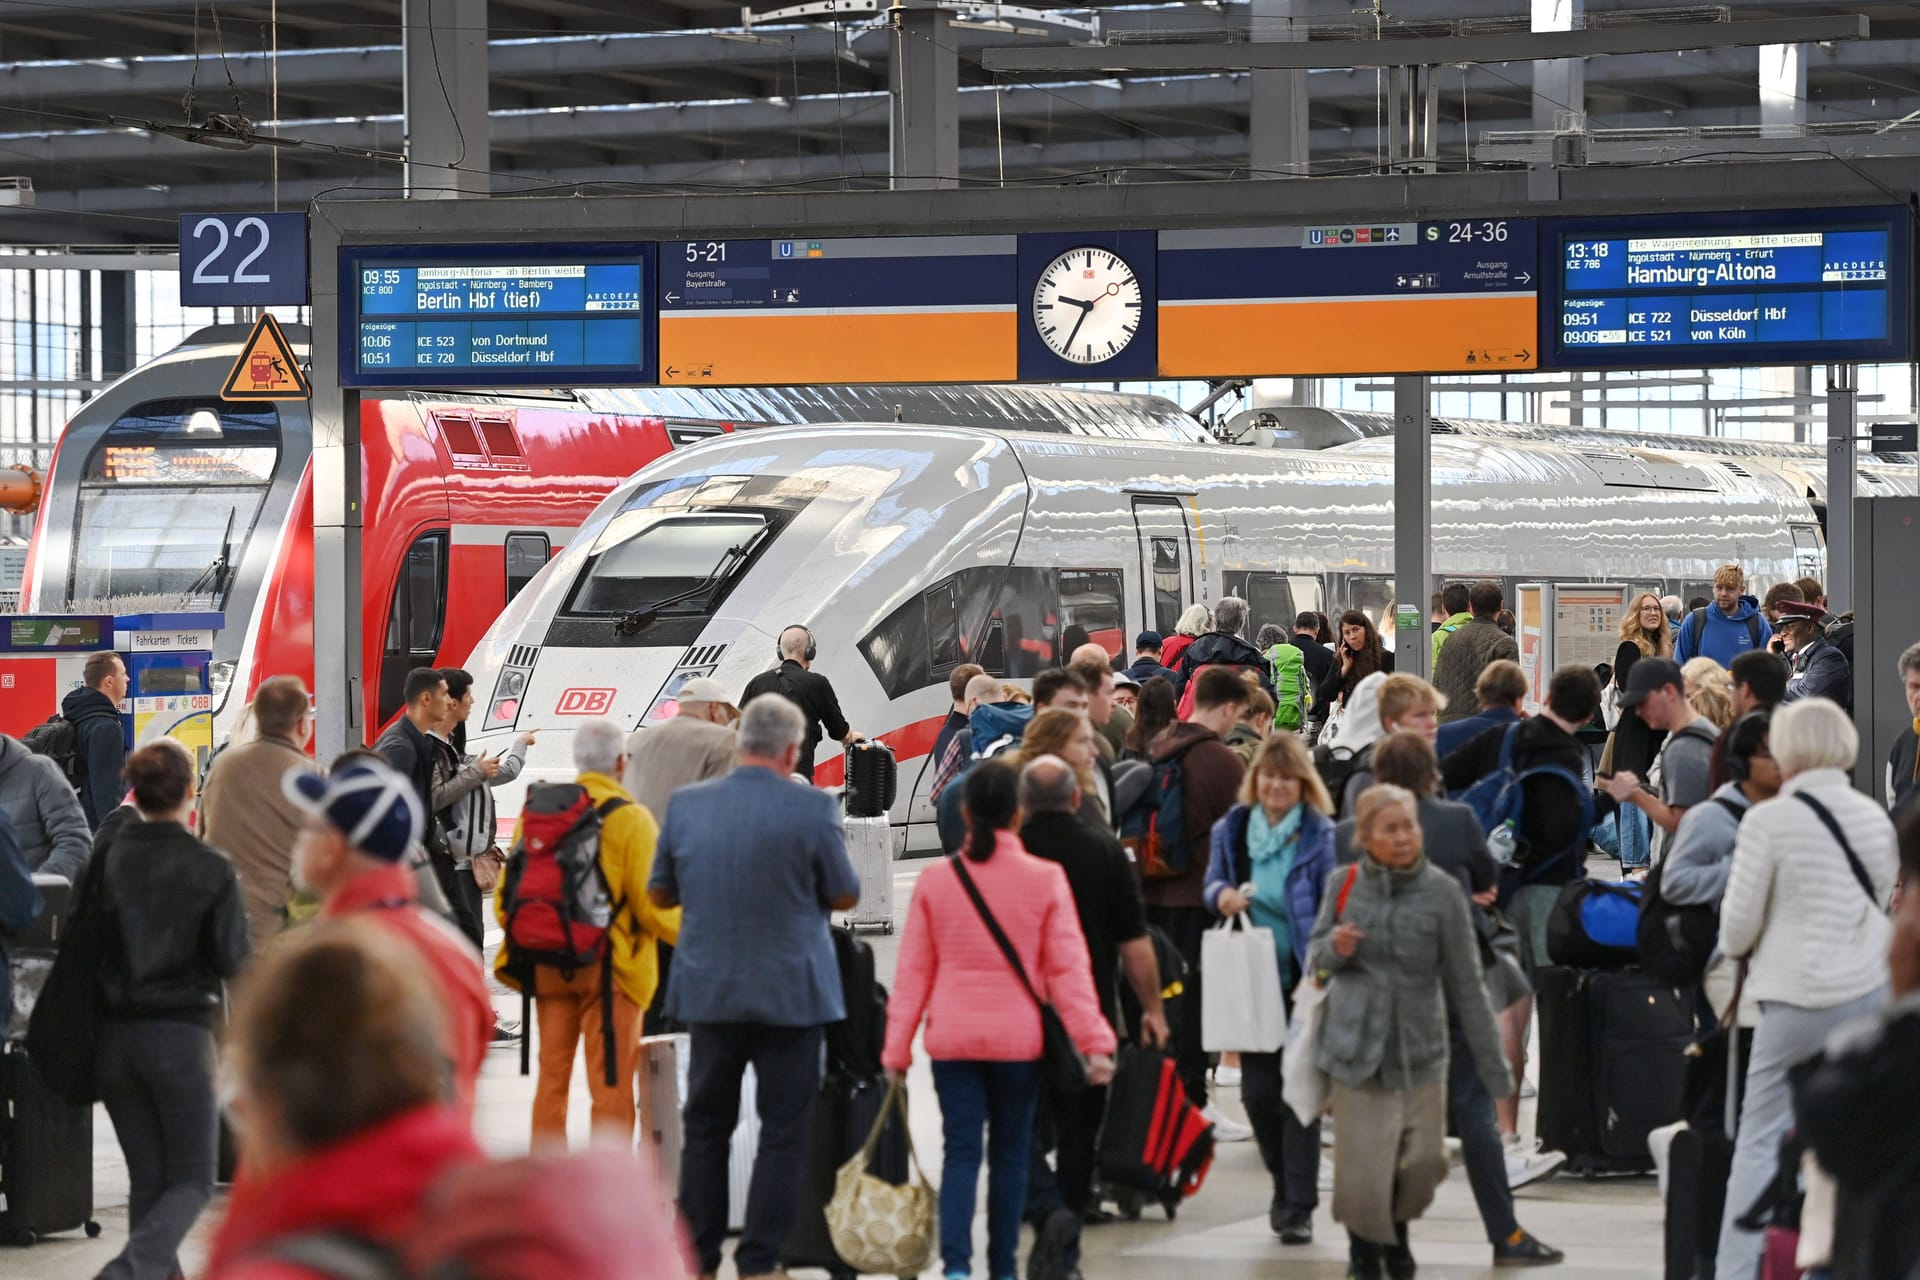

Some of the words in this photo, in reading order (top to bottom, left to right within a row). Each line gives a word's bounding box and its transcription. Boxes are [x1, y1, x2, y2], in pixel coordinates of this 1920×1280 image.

[1312, 231, 1321, 244] U
[1426, 227, 1438, 240] S
[1448, 221, 1508, 243] 24-36
[192, 217, 270, 283] 22
[686, 242, 726, 262] 5-21
[782, 243, 791, 257] U
[1567, 242, 1609, 258] 13:18
[1628, 252, 1675, 264] Ingolstadt
[1689, 251, 1731, 262] Nürnberg
[1745, 250, 1774, 259] Erfurt
[1476, 260, 1508, 270] Ausgang
[1566, 260, 1581, 270] ICE
[1584, 260, 1600, 269] 786
[363, 270, 400, 284] 09:55
[686, 270, 715, 279] Ausgang
[1464, 270, 1508, 279] Arnulfstraße
[1628, 263, 1776, 286] Hamburg-Altona
[363, 286, 376, 294] ICE
[378, 286, 393, 294] 800
[418, 281, 458, 291] Ingolstadt
[470, 280, 507, 291] Nürnberg
[518, 280, 553, 290] Bamberg
[686, 280, 726, 288] Bayerstraße
[418, 293, 462, 310] Berlin
[469, 292, 496, 309] Hbf
[504, 291, 541, 308] (tief)
[1563, 312, 1598, 326] 09:51
[1628, 313, 1646, 324] ICE
[1650, 312, 1672, 323] 722
[1690, 308, 1759, 322] Düsseldorf
[1764, 308, 1787, 320] Hbf
[472, 337, 491, 346] von
[496, 334, 548, 346] Dortmund
[1563, 330, 1598, 344] 09:06
[1628, 330, 1646, 342] ICE
[1650, 330, 1671, 341] 521
[1691, 330, 1713, 340] von
[1718, 328, 1746, 340] Köln
[361, 336, 391, 348] 10:06
[418, 336, 432, 346] ICE
[436, 336, 455, 346] 523
[361, 352, 390, 364] 10:51
[418, 354, 432, 364] ICE
[436, 353, 455, 364] 720
[472, 351, 531, 363] Düsseldorf
[535, 350, 555, 362] Hbf
[136, 634, 170, 646] Fahrkarten
[177, 634, 198, 645] Tickets
[563, 692, 607, 711] DB
